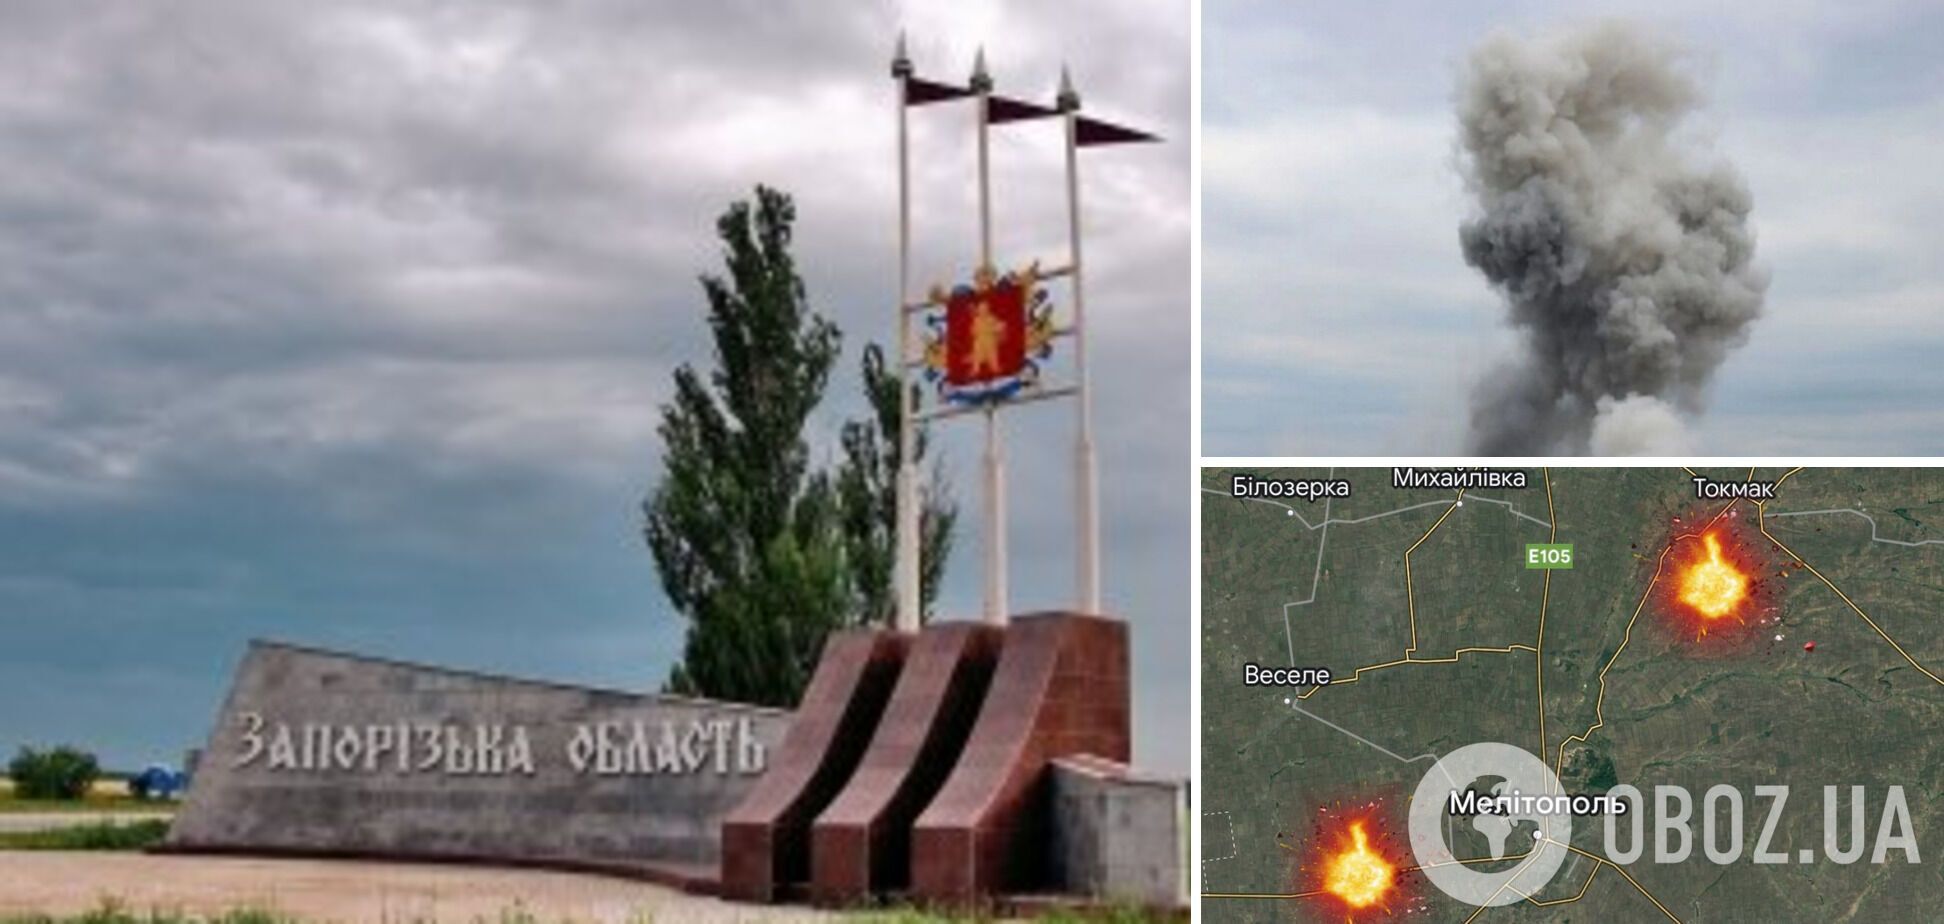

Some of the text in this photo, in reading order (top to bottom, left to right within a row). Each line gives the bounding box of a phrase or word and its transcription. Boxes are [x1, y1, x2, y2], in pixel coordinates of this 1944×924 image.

[1233, 476, 1350, 500] Білозерка
[1393, 467, 1526, 488] Михайлівка
[1693, 478, 1775, 499] Токмак
[1528, 549, 1571, 565] E105
[1244, 666, 1331, 685] Веселе
[1449, 790, 1627, 816] Мелітополь
